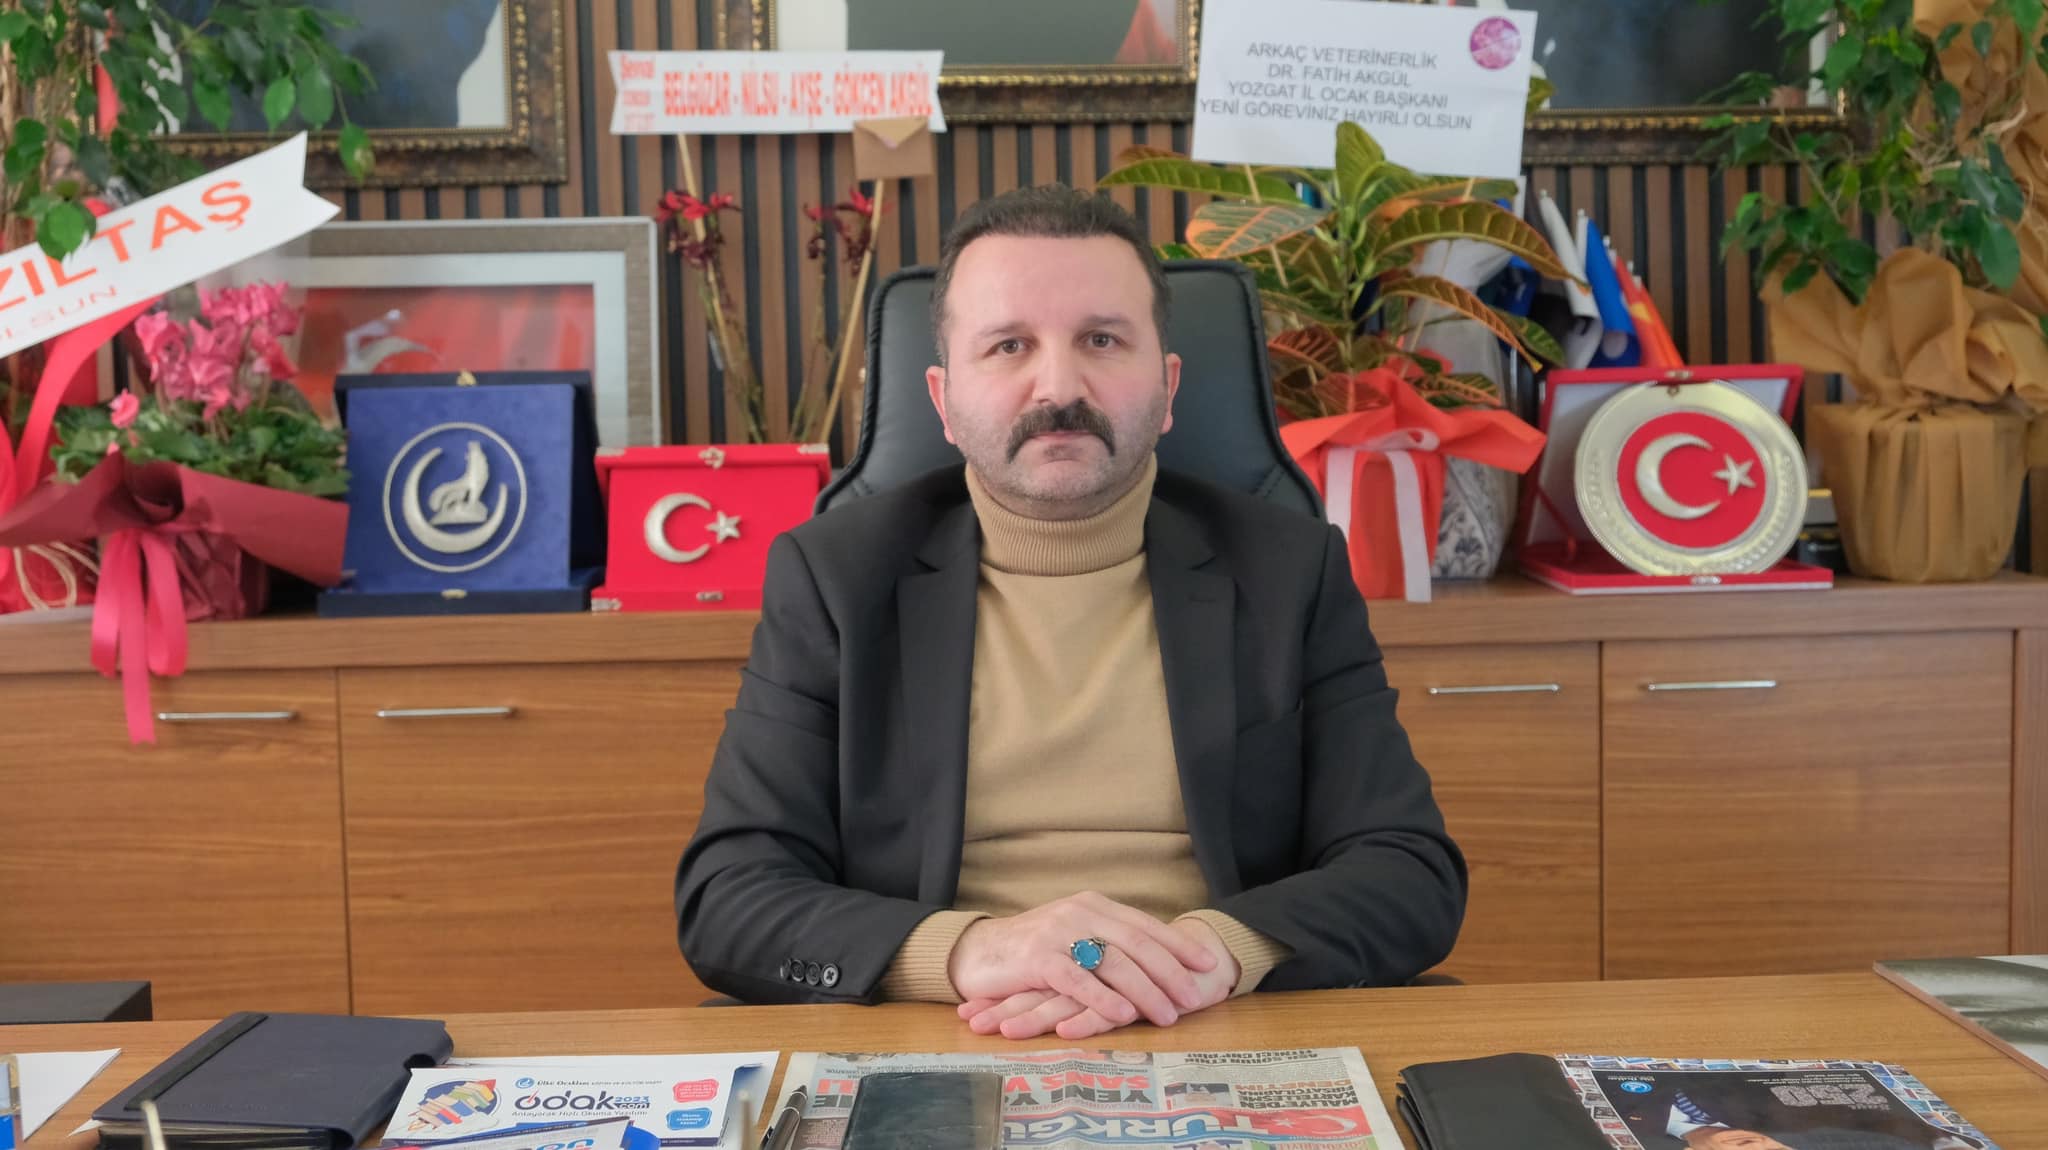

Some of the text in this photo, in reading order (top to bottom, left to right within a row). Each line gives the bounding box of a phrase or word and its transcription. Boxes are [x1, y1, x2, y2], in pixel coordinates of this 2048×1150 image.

[1247, 42, 1438, 70] ARKAÇ VETERİNERLİK
[890, 63, 933, 116] AKGÜL
[1303, 65, 1351, 83] FATİH
[1355, 69, 1412, 88] AKGÜL
[1228, 81, 1449, 110] YOZGAT İL OCAK BAŞKANI
[1199, 98, 1473, 130] YENİ GÖREVİNİZ HAYIRLI OLSUN
[615, 1095, 651, 1103] 2023
[1051, 1084, 1153, 1105] YENİ
[1769, 1084, 1888, 1107] 250
[1003, 1112, 1271, 1138] TÜRKGÜ
